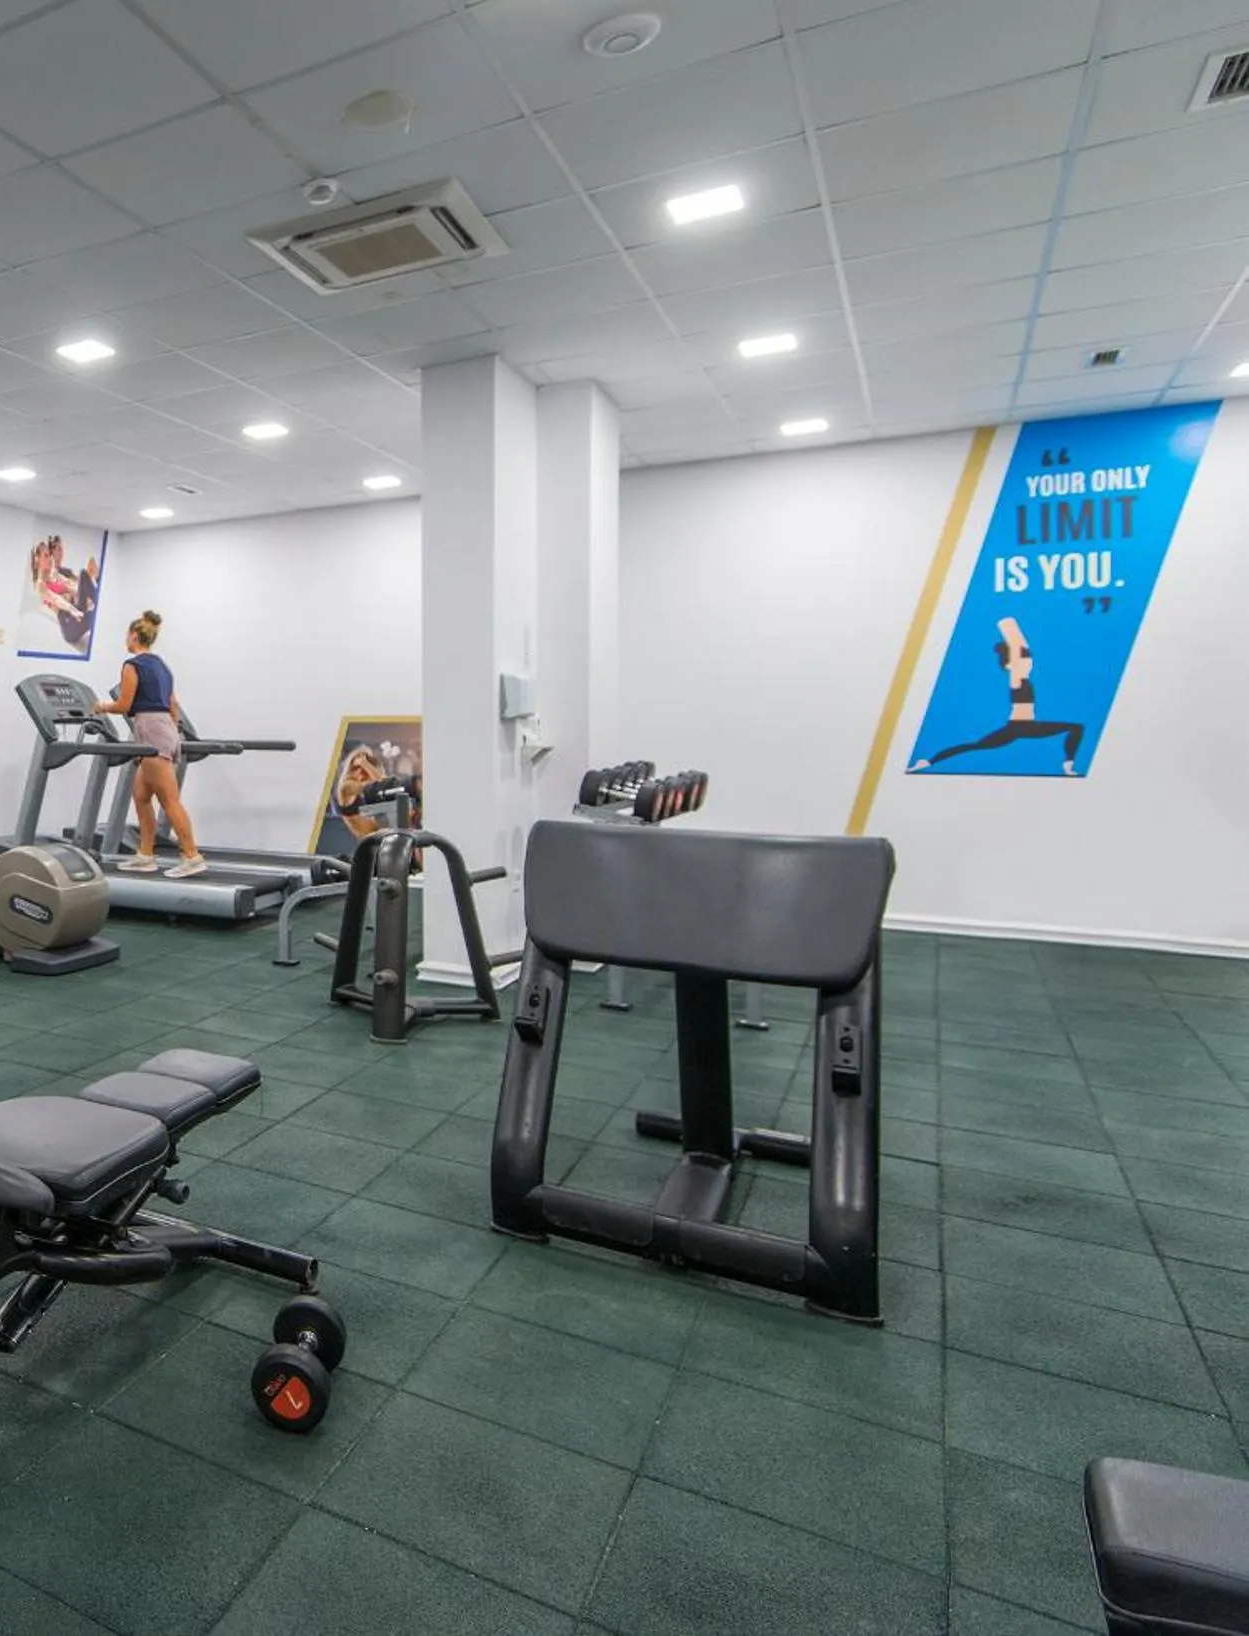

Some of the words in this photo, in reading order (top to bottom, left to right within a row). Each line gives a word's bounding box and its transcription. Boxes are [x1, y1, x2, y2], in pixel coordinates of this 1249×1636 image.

[1026, 471, 1086, 498] YOUR
[1091, 464, 1150, 492] ONLY
[1016, 496, 1137, 545] LIMIT
[994, 556, 1029, 592] IS
[1037, 551, 1125, 591] YOU.
